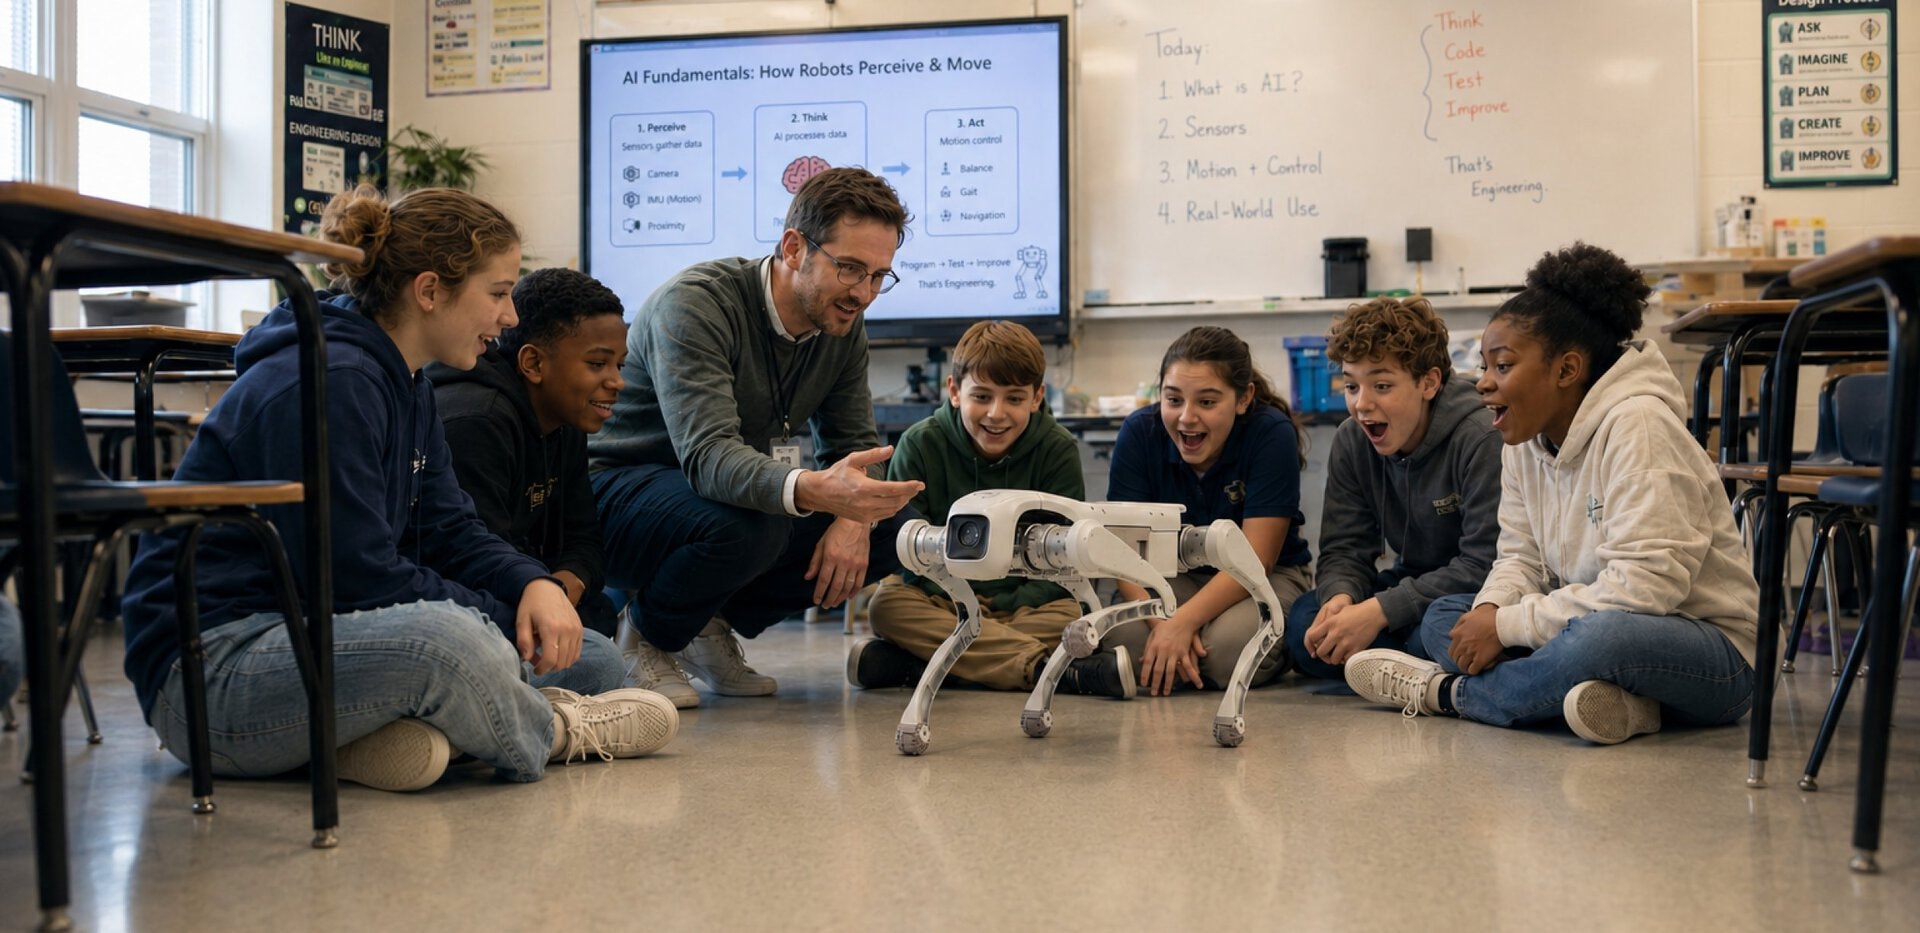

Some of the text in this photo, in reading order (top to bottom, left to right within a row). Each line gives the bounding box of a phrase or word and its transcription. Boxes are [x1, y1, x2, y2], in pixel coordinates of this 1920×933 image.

[1434, 10, 1484, 32] Think
[1798, 22, 1821, 34] ASK
[312, 23, 362, 52] THINK
[1145, 28, 1209, 65] Today:
[1445, 40, 1486, 60] Code
[1798, 53, 1848, 66] IMAGINE
[623, 57, 992, 84] AI Fundamentals: How Robots Perceive & Move
[1443, 71, 1483, 90] Test
[1184, 79, 1223, 97] What
[1236, 80, 1248, 94] is
[1798, 85, 1829, 97] PLAN
[1446, 100, 1510, 121] Improve
[791, 112, 828, 123] 2. Think
[957, 118, 984, 128] 3. Act
[1798, 117, 1842, 130] CREATE
[289, 121, 350, 143] ENGINEERING
[638, 122, 686, 133] 1. Perceive
[1159, 115, 1247, 139] 2. Sensors
[774, 130, 847, 142] AI processes data
[940, 135, 1002, 145] Motion control
[622, 140, 702, 152] Sensors gather data
[1799, 150, 1850, 162] IMPROVE
[960, 164, 993, 173] Balance
[1159, 161, 1175, 184] 3.
[1187, 159, 1237, 180] Motion
[1267, 151, 1322, 175] Control
[1444, 155, 1493, 174] That's
[647, 169, 679, 178] Camera
[960, 187, 977, 196] Gait
[1472, 180, 1548, 203] Engineering.
[648, 194, 702, 205] IMU (Motion)
[1158, 196, 1319, 224] 4. Real-World Use
[960, 212, 1005, 222] Navigation
[648, 222, 685, 232] Proximity
[900, 259, 1011, 271] Program Test Improve
[919, 280, 996, 289] That's Engineering.
